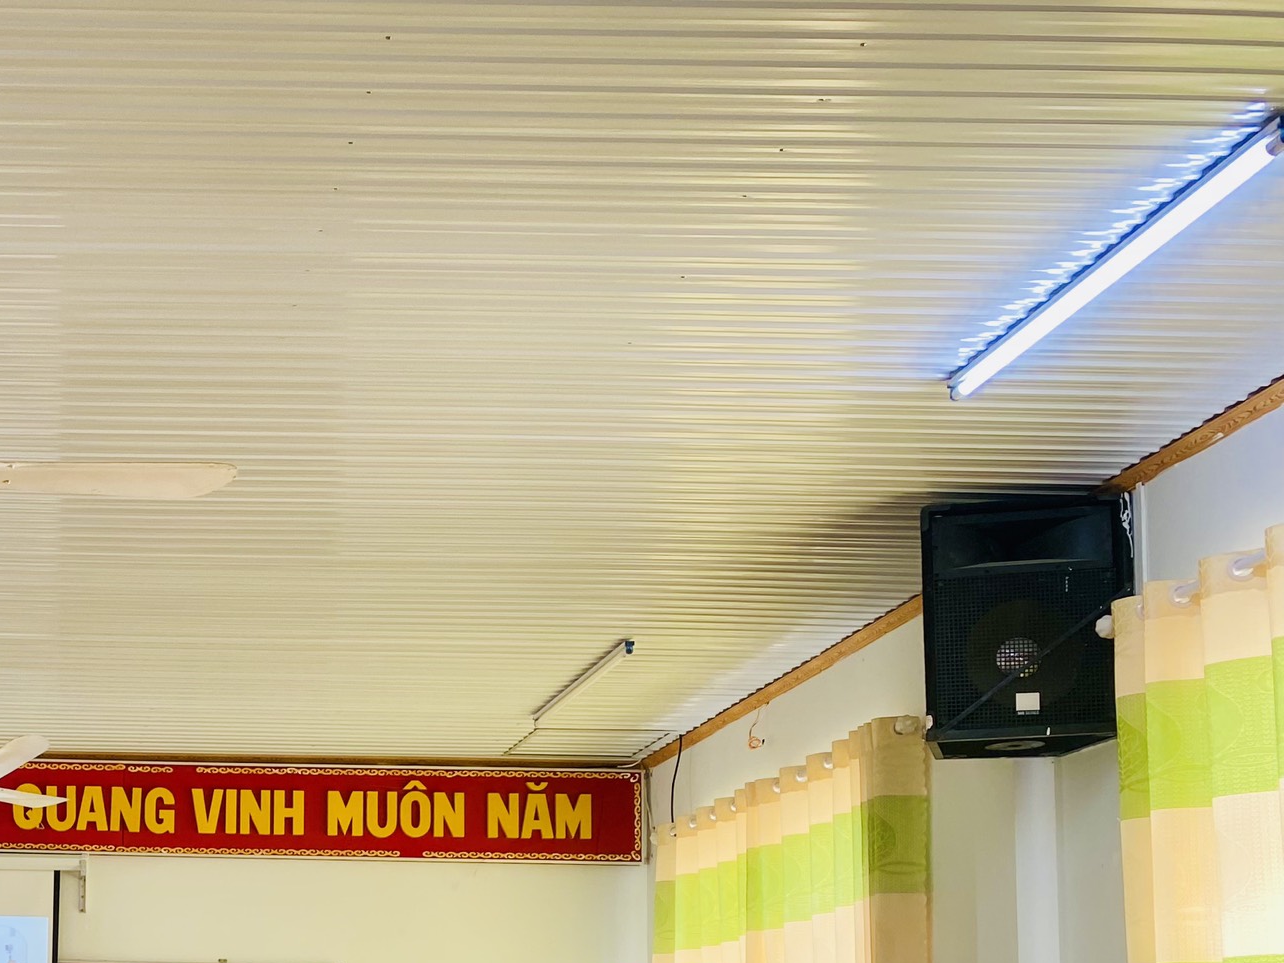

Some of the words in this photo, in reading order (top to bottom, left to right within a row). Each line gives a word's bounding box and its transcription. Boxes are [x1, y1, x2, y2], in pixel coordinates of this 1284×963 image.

[12, 783, 177, 834] QUANG
[191, 788, 306, 837] VINH
[327, 779, 465, 839] MUÔN
[487, 783, 593, 840] NĂM
